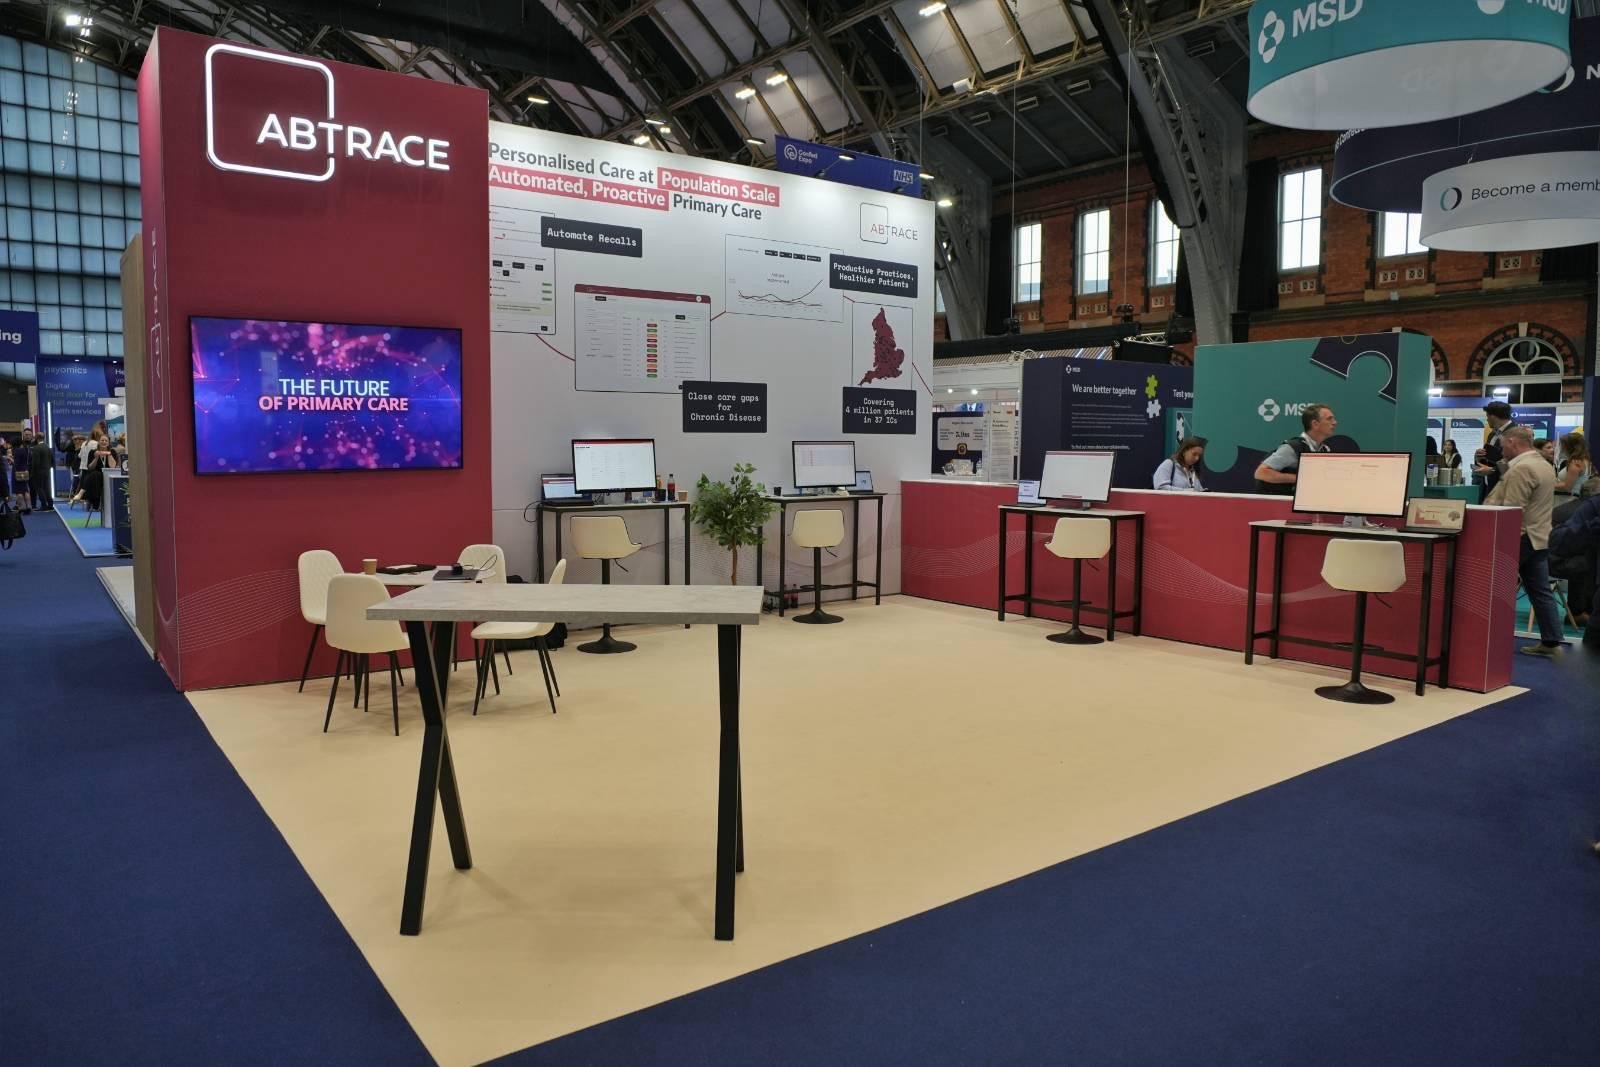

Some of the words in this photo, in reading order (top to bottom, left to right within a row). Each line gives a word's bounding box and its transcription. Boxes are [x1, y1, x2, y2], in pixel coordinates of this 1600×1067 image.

[1292, 0, 1364, 37] MSD
[256, 113, 451, 171] ABTRACE
[489, 143, 595, 174] Personalised
[599, 161, 635, 181] Care
[639, 170, 654, 185] at
[661, 171, 739, 199] Population
[742, 184, 776, 203] Scale
[894, 170, 913, 184] NHS
[489, 165, 588, 197] Automated,
[592, 184, 666, 207] Proactive
[673, 193, 728, 218] Primary
[732, 203, 762, 221] Care
[1471, 184, 1536, 200] Become
[1541, 182, 1551, 192] a
[547, 227, 594, 242] Automate
[598, 233, 638, 247] Recalls
[870, 223, 919, 241] ABTRACE
[833, 262, 874, 276] Productive
[877, 268, 915, 282] Practices,
[839, 273, 876, 285] Healthier
[878, 277, 909, 289] Patients
[279, 378, 315, 396] THE
[321, 379, 390, 397] FUTURE
[1072, 384, 1082, 393] We
[1093, 385, 1112, 394] better
[1112, 387, 1137, 397] together
[1173, 389, 1184, 398] Test
[259, 396, 283, 411] OF
[287, 397, 363, 411] PRIMARY
[367, 397, 409, 411] CARE
[688, 392, 713, 402] Close
[717, 393, 737, 402] care
[740, 395, 760, 404] gaps
[863, 398, 895, 408] Covering
[717, 403, 732, 411] for
[845, 406, 851, 414] 4
[853, 406, 882, 415] million
[884, 407, 915, 416] patients
[1284, 403, 1314, 416] MS
[690, 412, 725, 422] Chronic
[729, 413, 762, 423] Disease
[863, 416, 872, 424] in
